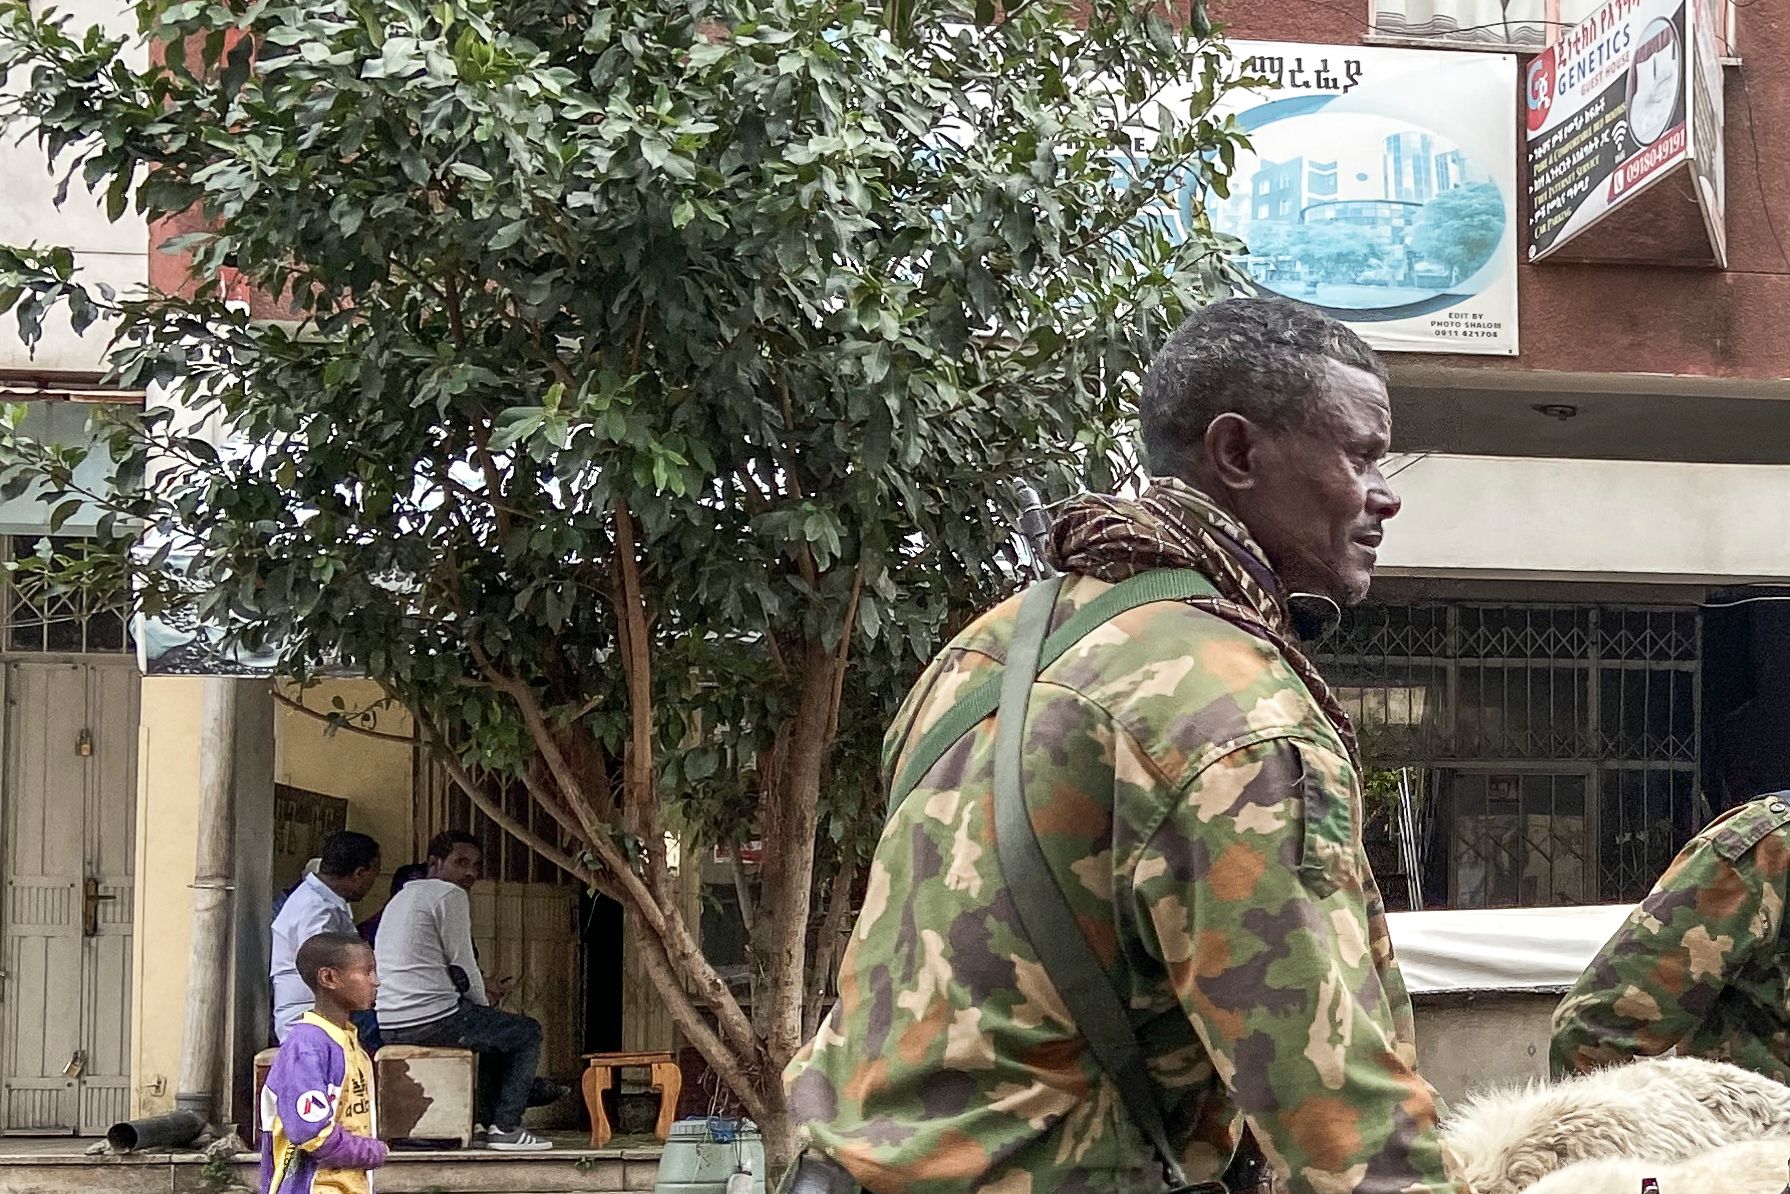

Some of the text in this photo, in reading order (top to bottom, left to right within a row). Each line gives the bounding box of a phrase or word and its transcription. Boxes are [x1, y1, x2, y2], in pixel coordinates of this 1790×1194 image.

[1558, 23, 1631, 95] GENETICS
[1581, 50, 1630, 96] GUEST HOUSE
[1626, 129, 1685, 182] 0918049191
[1430, 320, 1502, 329] PHOTO SHALOM
